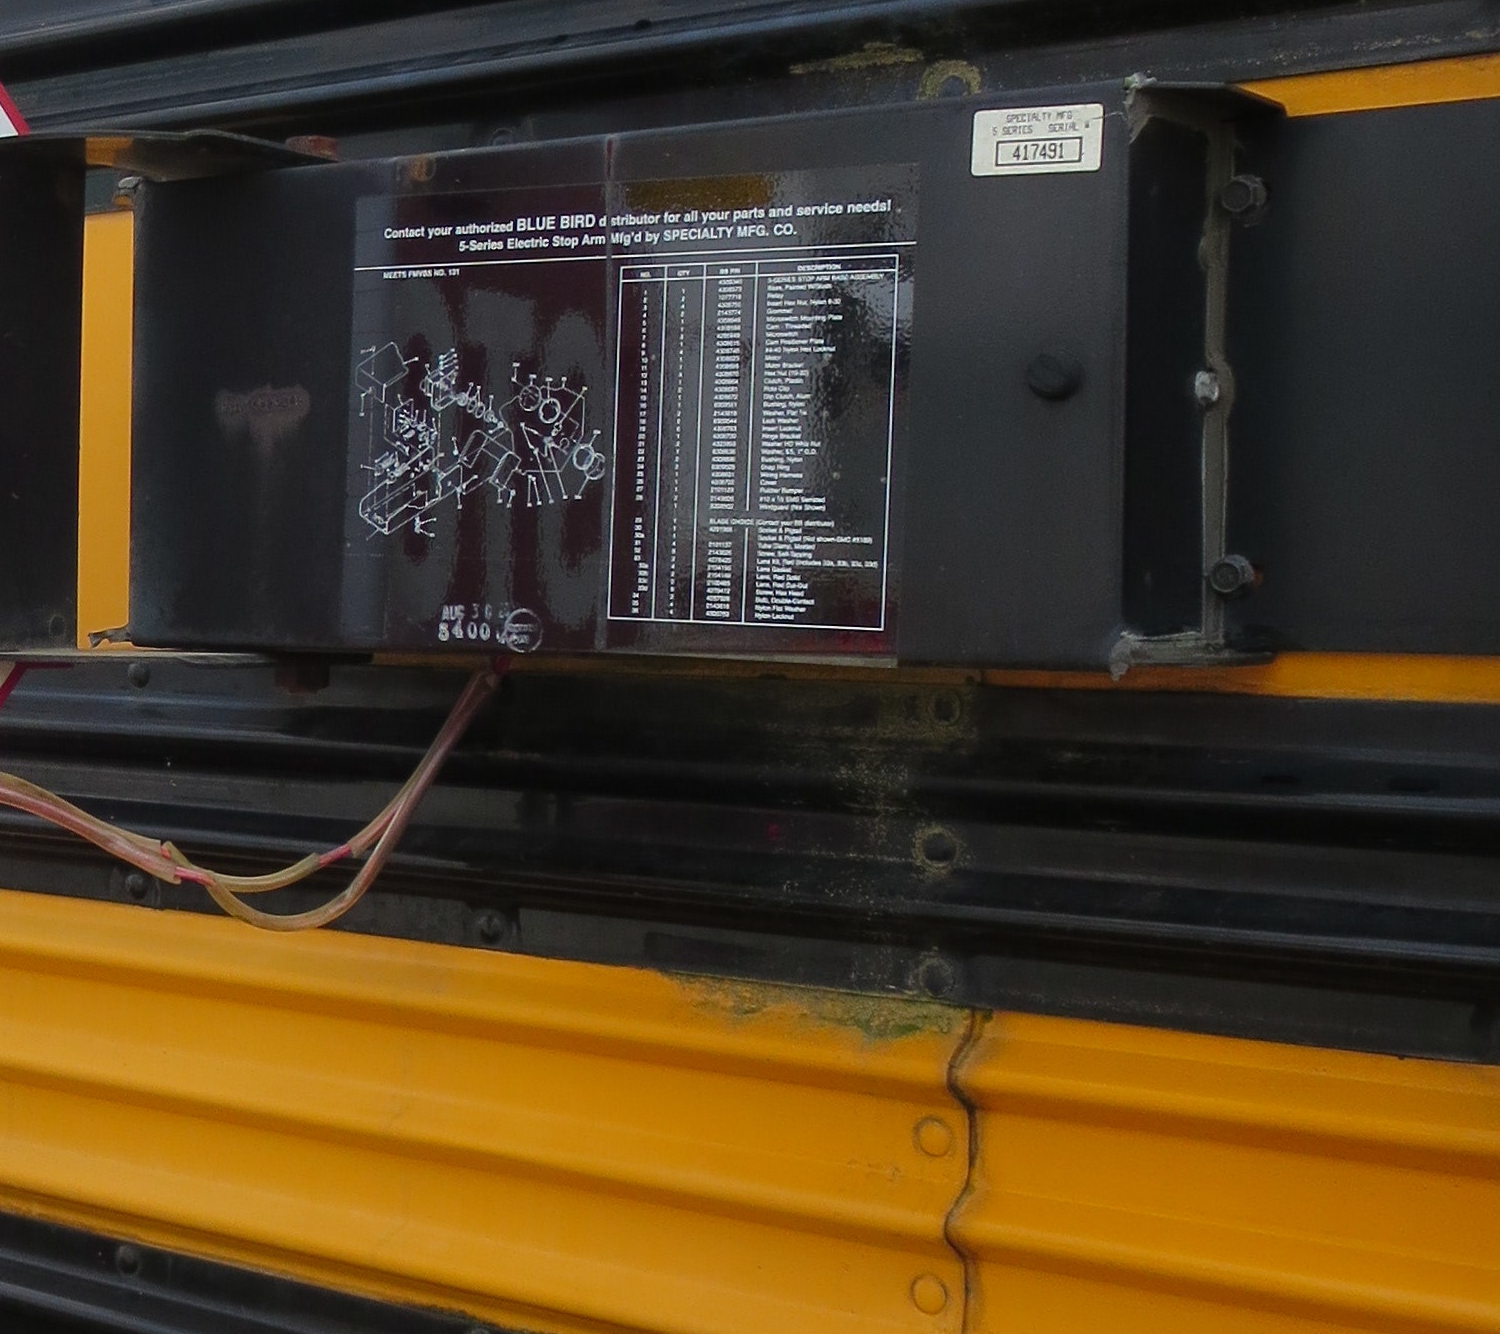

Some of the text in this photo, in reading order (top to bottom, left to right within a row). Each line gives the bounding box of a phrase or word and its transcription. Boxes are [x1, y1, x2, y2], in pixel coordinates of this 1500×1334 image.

[1006, 110, 1073, 123] SPECIALTY MFG
[1002, 125, 1033, 136] SERIES
[1048, 122, 1079, 133] SERIAL
[1012, 142, 1064, 161] 417491
[384, 199, 892, 239] Contact your authorized BLUE BIRD dstributor for all your parts and service needs!
[458, 223, 797, 252] 5-Series Electric Stop Arm Mfg'd by SPECIALTY MFG. CO.
